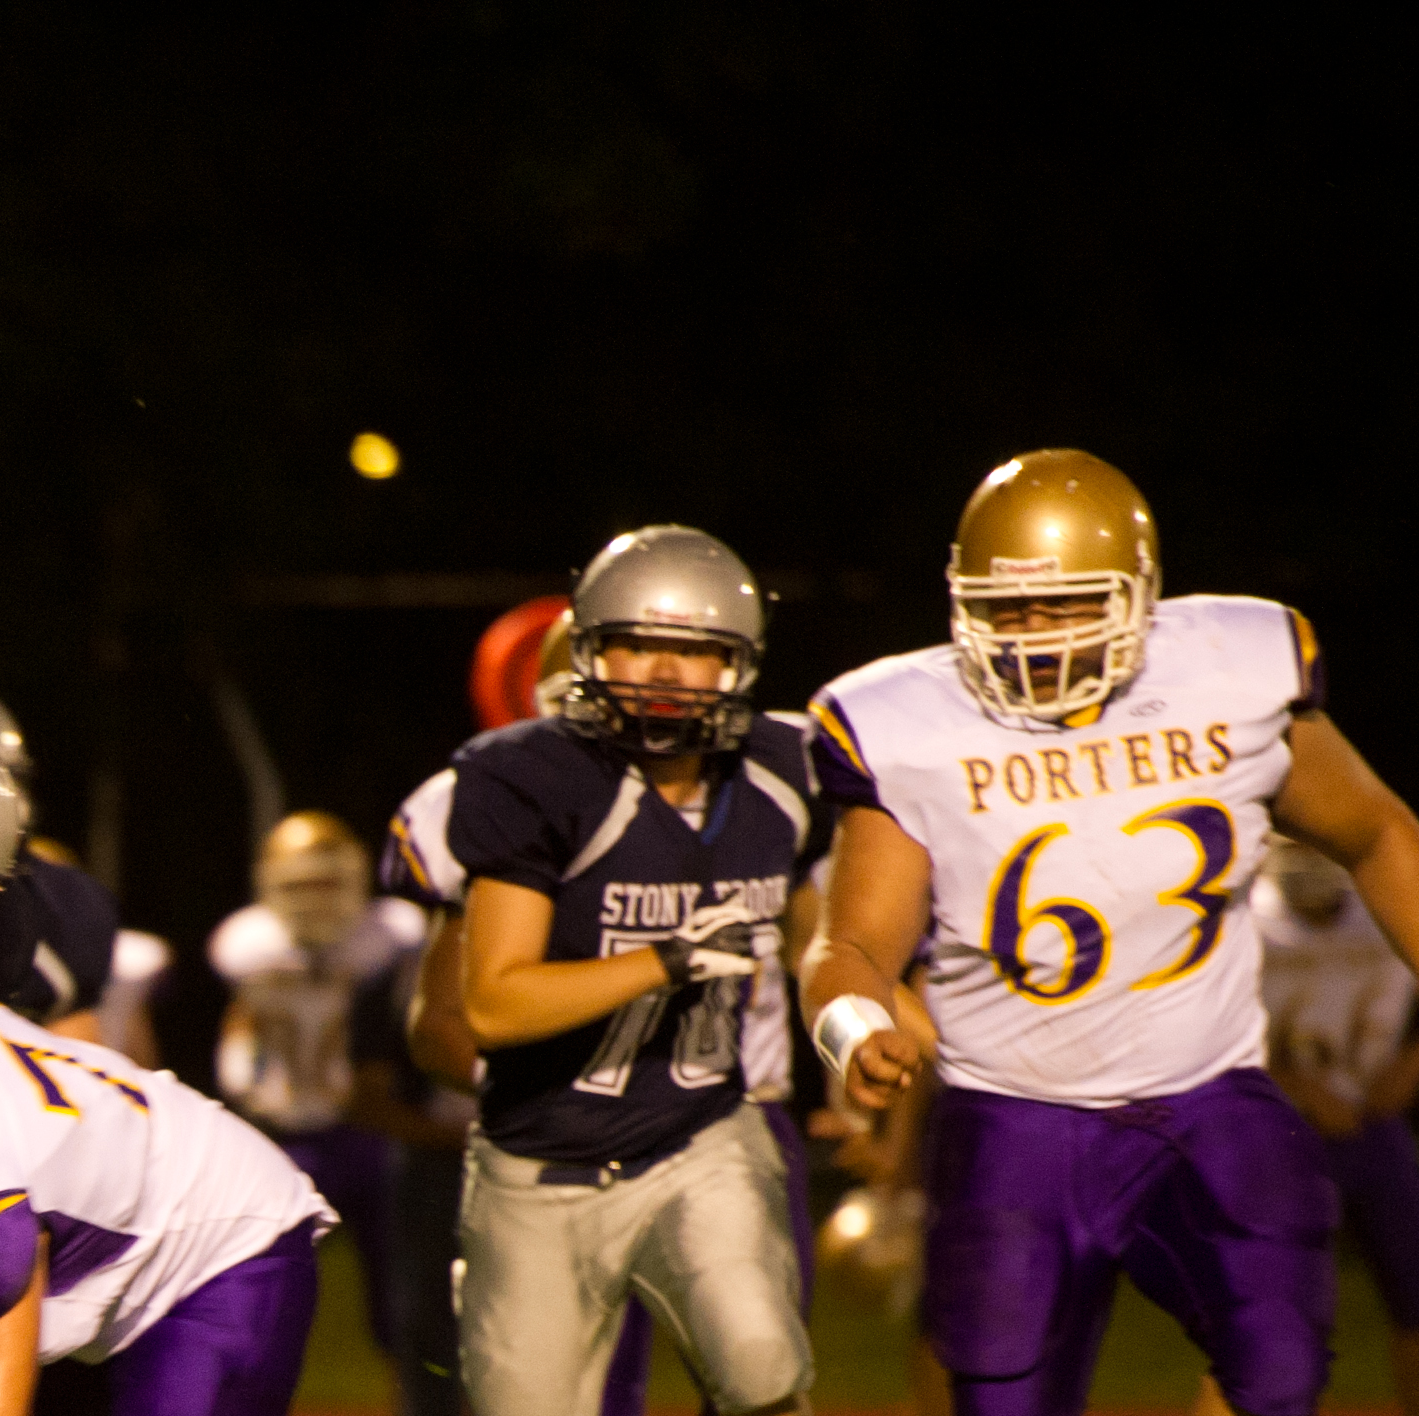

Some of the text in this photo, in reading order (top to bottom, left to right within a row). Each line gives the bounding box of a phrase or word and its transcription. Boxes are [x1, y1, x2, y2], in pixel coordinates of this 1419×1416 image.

[960, 723, 1233, 814] PORTERS
[599, 882, 703, 927] STONY
[982, 797, 1237, 1006] 63
